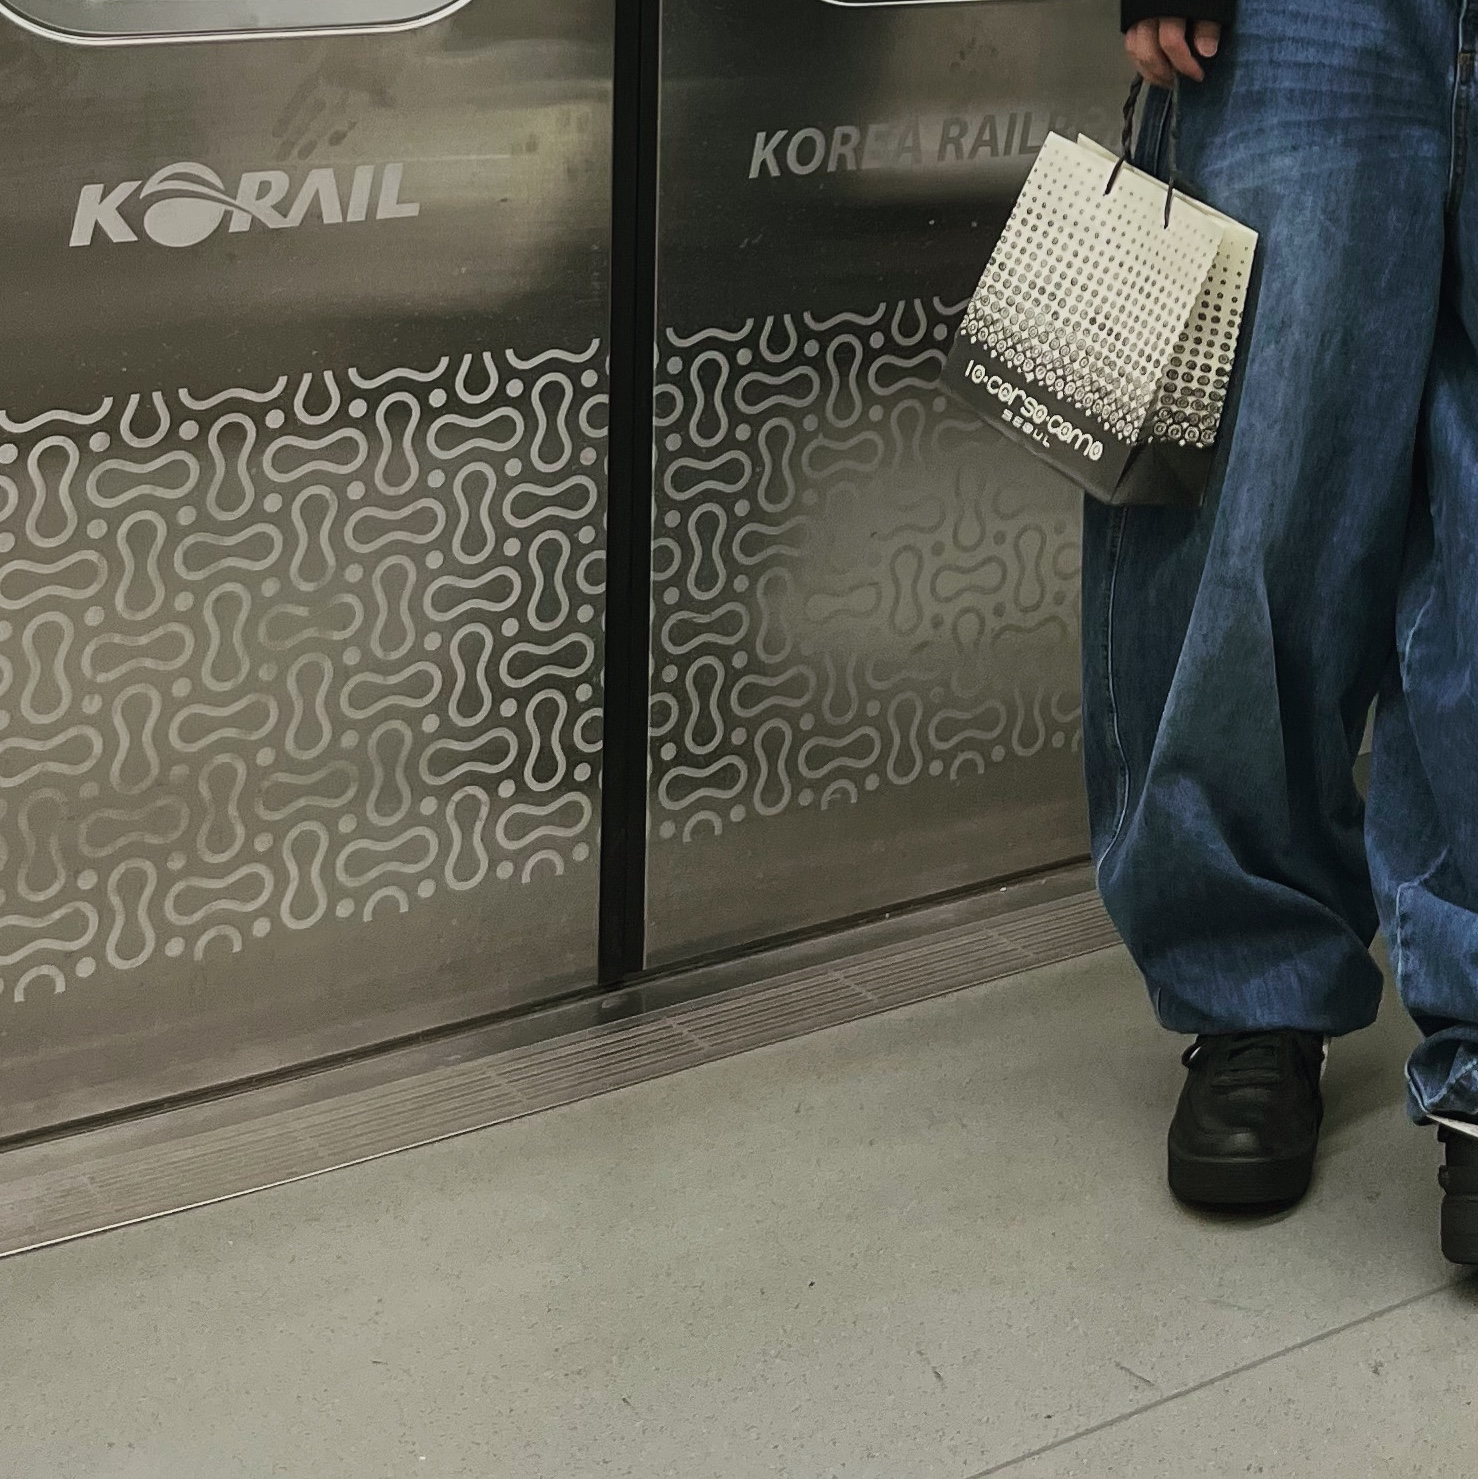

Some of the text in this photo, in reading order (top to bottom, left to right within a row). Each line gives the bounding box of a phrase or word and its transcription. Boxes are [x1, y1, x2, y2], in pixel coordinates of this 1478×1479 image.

[748, 117, 923, 179] KOREA
[69, 162, 421, 247] KORAIL
[1002, 408, 1050, 449] SEOUL
